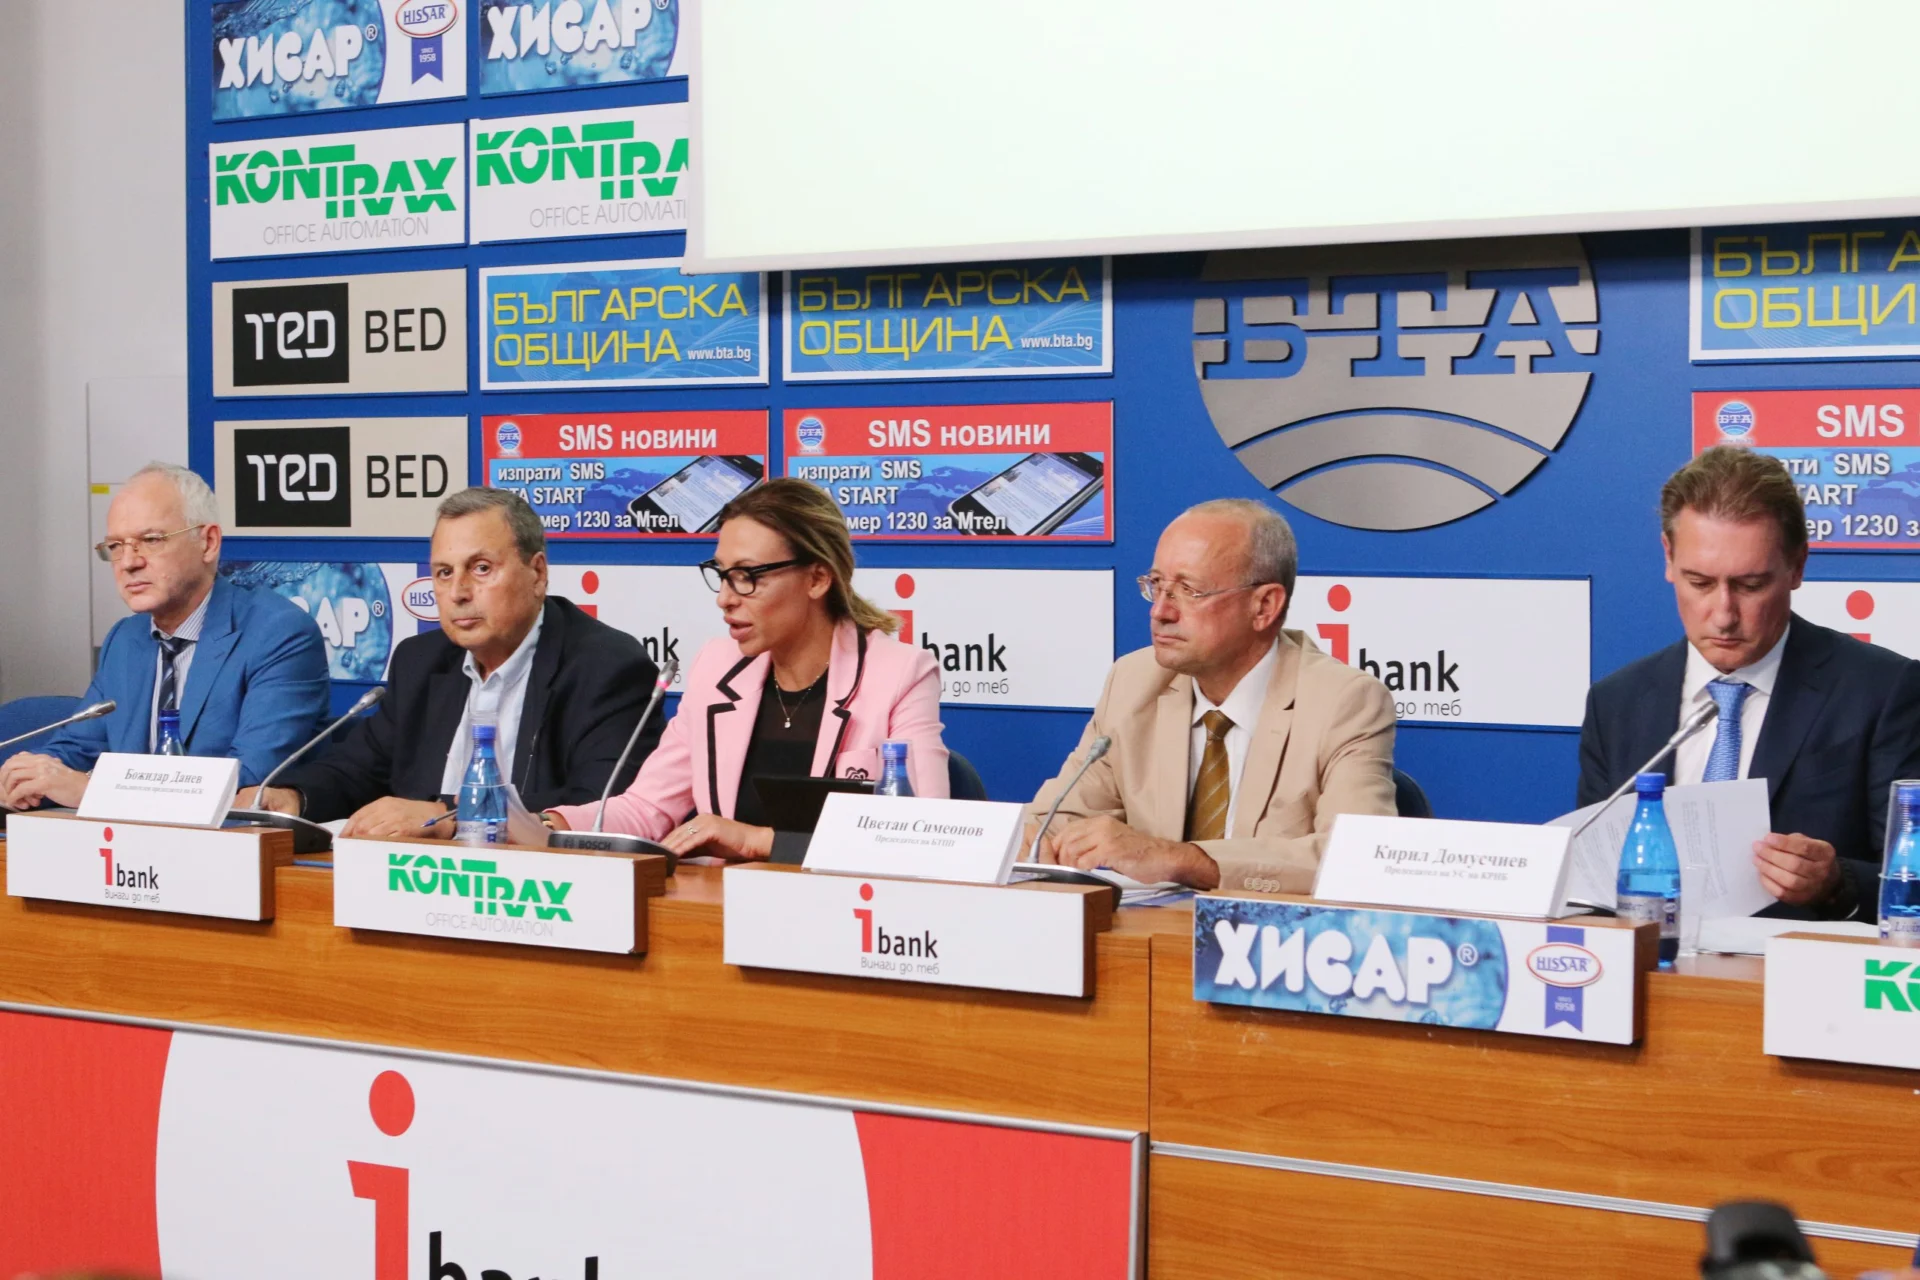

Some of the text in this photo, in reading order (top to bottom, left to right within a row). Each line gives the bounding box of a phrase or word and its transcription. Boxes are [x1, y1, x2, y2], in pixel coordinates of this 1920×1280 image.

[403, 4, 446, 25] HISSAR
[487, 0, 653, 60] ХИСАР
[218, 25, 363, 88] ХИСАР
[476, 120, 688, 200] KONTRA
[216, 144, 457, 219] KONTRAX
[530, 201, 687, 229] OFFICE AUTOMATI
[263, 216, 429, 245] OFFICE AUTOMATION
[1713, 230, 1920, 277] БЪЛГА
[799, 267, 1090, 312] БЪЛГАРСКА
[493, 283, 748, 326] БЪЛГАРСКА
[1713, 283, 1917, 335] ОБЩИ
[365, 307, 447, 354] BED
[1197, 267, 1596, 381] БТА
[493, 329, 680, 372] ОБЩИНА
[799, 315, 1014, 361] ОБЩИНА
[1020, 333, 1094, 351] www.bta.bg
[687, 345, 752, 363] www.bta.bg
[868, 419, 1051, 448] SMS новини
[1816, 404, 1905, 438] SMS
[559, 424, 717, 451] SMS новини
[366, 454, 448, 499] BED
[498, 462, 605, 485] изпрати SMS
[798, 460, 922, 484] изпрати SMS
[1834, 453, 1890, 475] SMS
[533, 487, 585, 504] START
[838, 486, 898, 505] START
[540, 511, 679, 532] мер 1230 за Мтел
[846, 511, 1006, 534] мер 1230 за Мтел
[1841, 514, 1899, 536] 1230
[410, 591, 436, 607] HISS
[124, 768, 203, 784] Божидар Данев
[857, 815, 984, 837] Цветан Симеонов
[578, 840, 611, 851] BOSCH
[1374, 844, 1528, 869] Кирил Домусчиев
[389, 853, 573, 922] KONTRAX
[425, 912, 554, 937] OFFICE AUTOMATION
[1213, 920, 1452, 1004] ХИСАР
[1536, 956, 1587, 972] HISSAR
